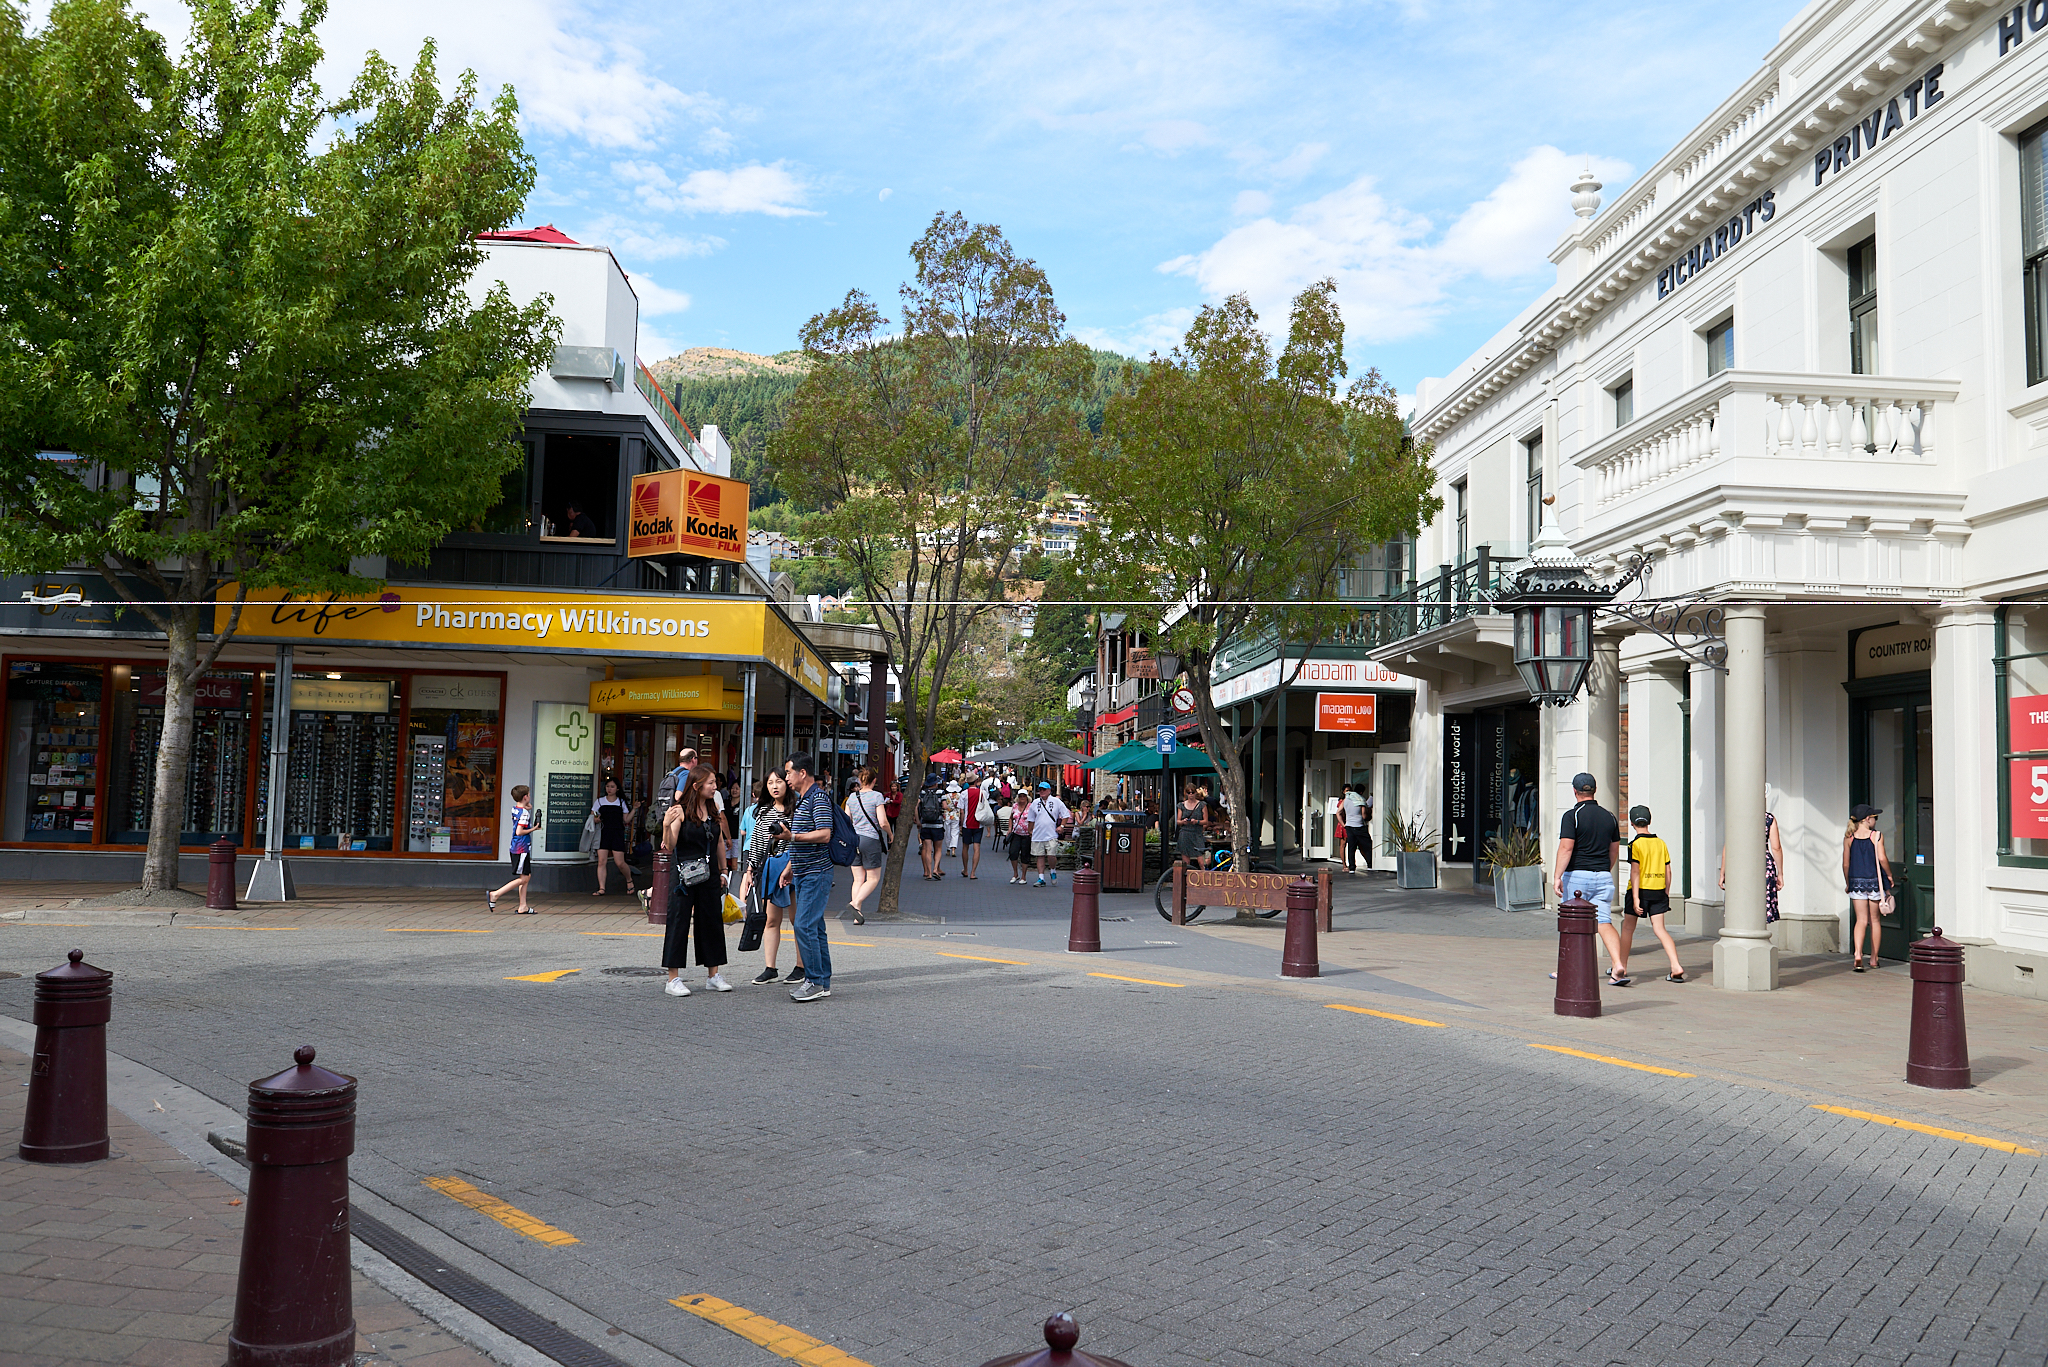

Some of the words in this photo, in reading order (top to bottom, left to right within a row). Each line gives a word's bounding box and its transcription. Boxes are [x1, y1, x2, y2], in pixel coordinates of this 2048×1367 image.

[1657, 190, 1776, 301] EICHARDT'S
[1814, 63, 1945, 187] PRIVATE
[633, 516, 673, 537] Kodak
[686, 516, 738, 541] Kodak
[657, 534, 676, 545] FILM
[717, 541, 741, 553] FILM
[271, 592, 380, 635] life
[416, 603, 553, 638] Pharmacy
[560, 608, 710, 638] Wilkinsons
[1869, 640, 1912, 659] COUNTRY
[1914, 637, 1931, 653] ROA
[195, 685, 232, 698] ollé
[298, 690, 383, 700] SERENGETI
[450, 682, 464, 697] ck
[467, 690, 497, 698] GUESS
[596, 688, 621, 706] life
[628, 691, 661, 702] Pharmacy
[662, 689, 700, 699] Wilkinsons
[766, 724, 785, 735] glob
[793, 724, 821, 735] cultu
[1451, 761, 1460, 818] untouched
[1224, 891, 1272, 909] MALL
